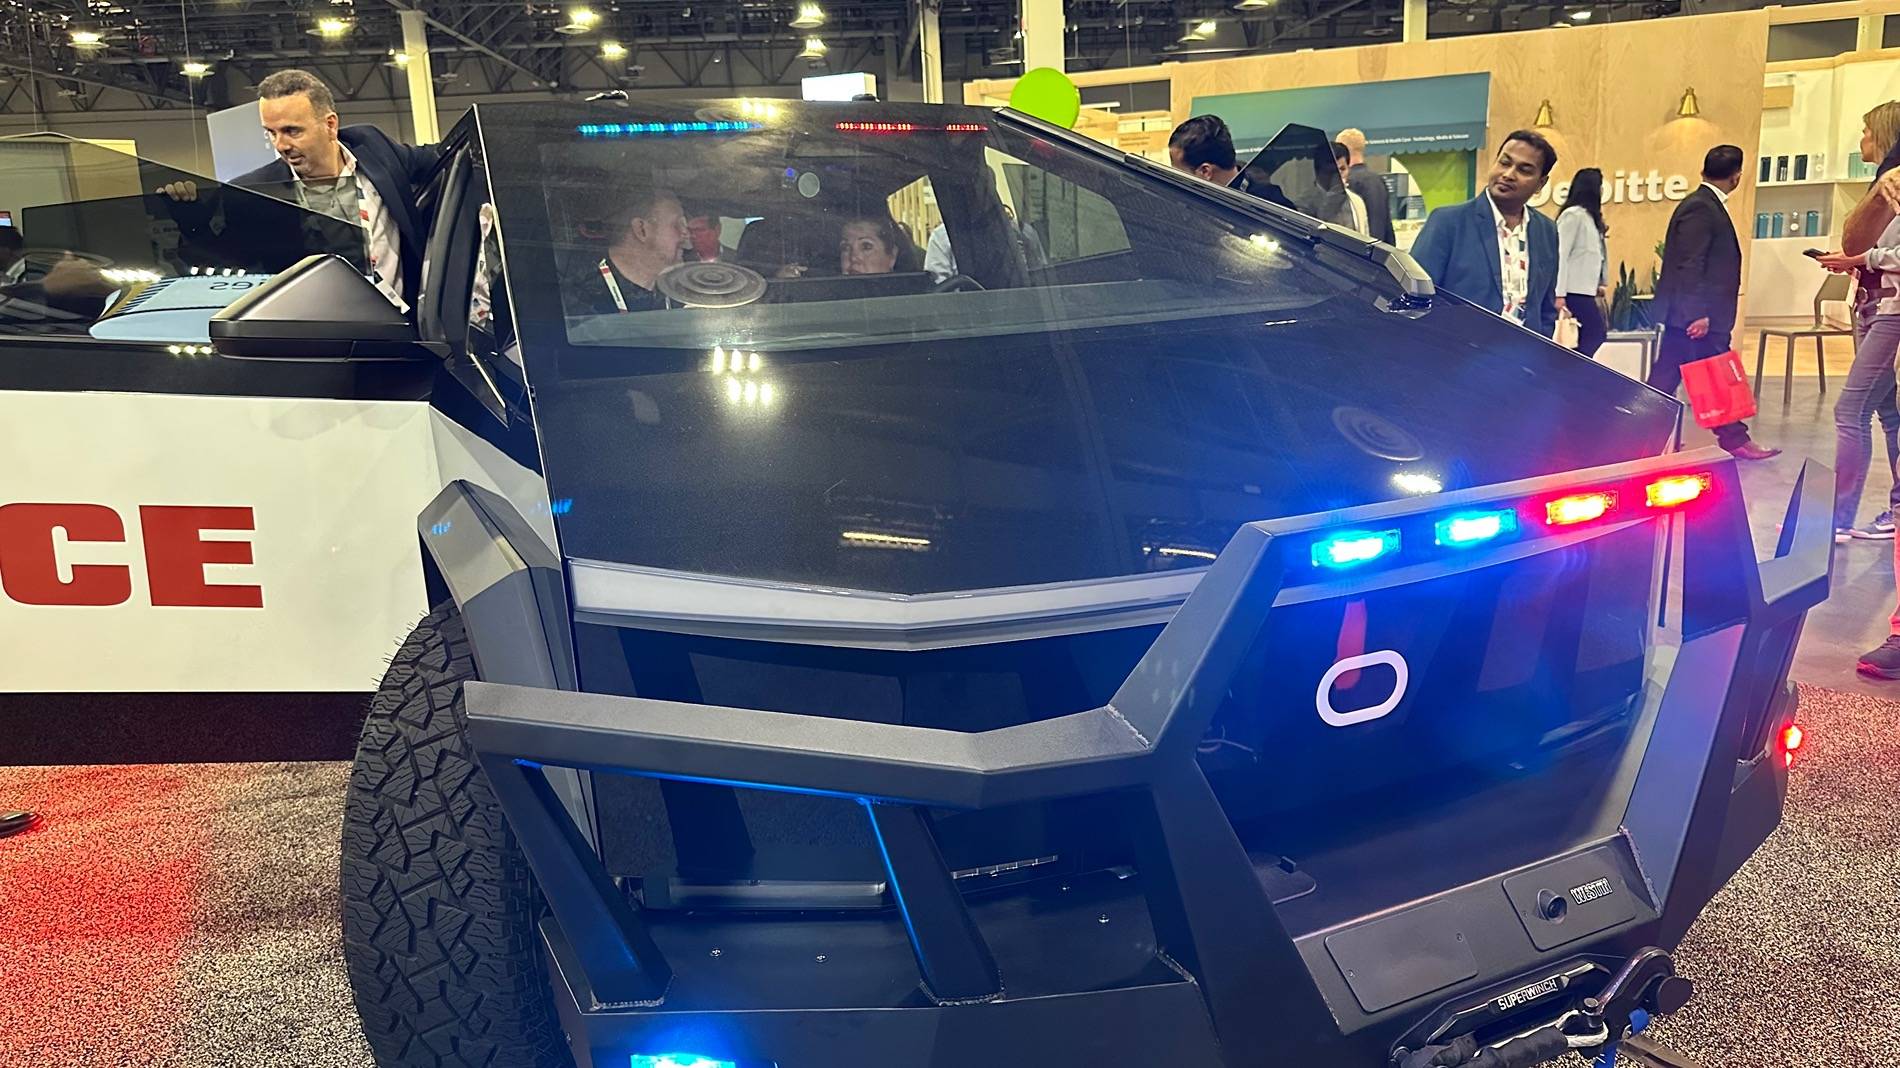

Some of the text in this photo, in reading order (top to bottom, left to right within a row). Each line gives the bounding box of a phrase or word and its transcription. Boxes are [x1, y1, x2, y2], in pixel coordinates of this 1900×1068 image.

[1527, 169, 1690, 208] eitte
[0, 502, 264, 608] CE
[1569, 877, 1613, 905] WESTIN
[1498, 978, 1558, 1011] SUPERWINCH
